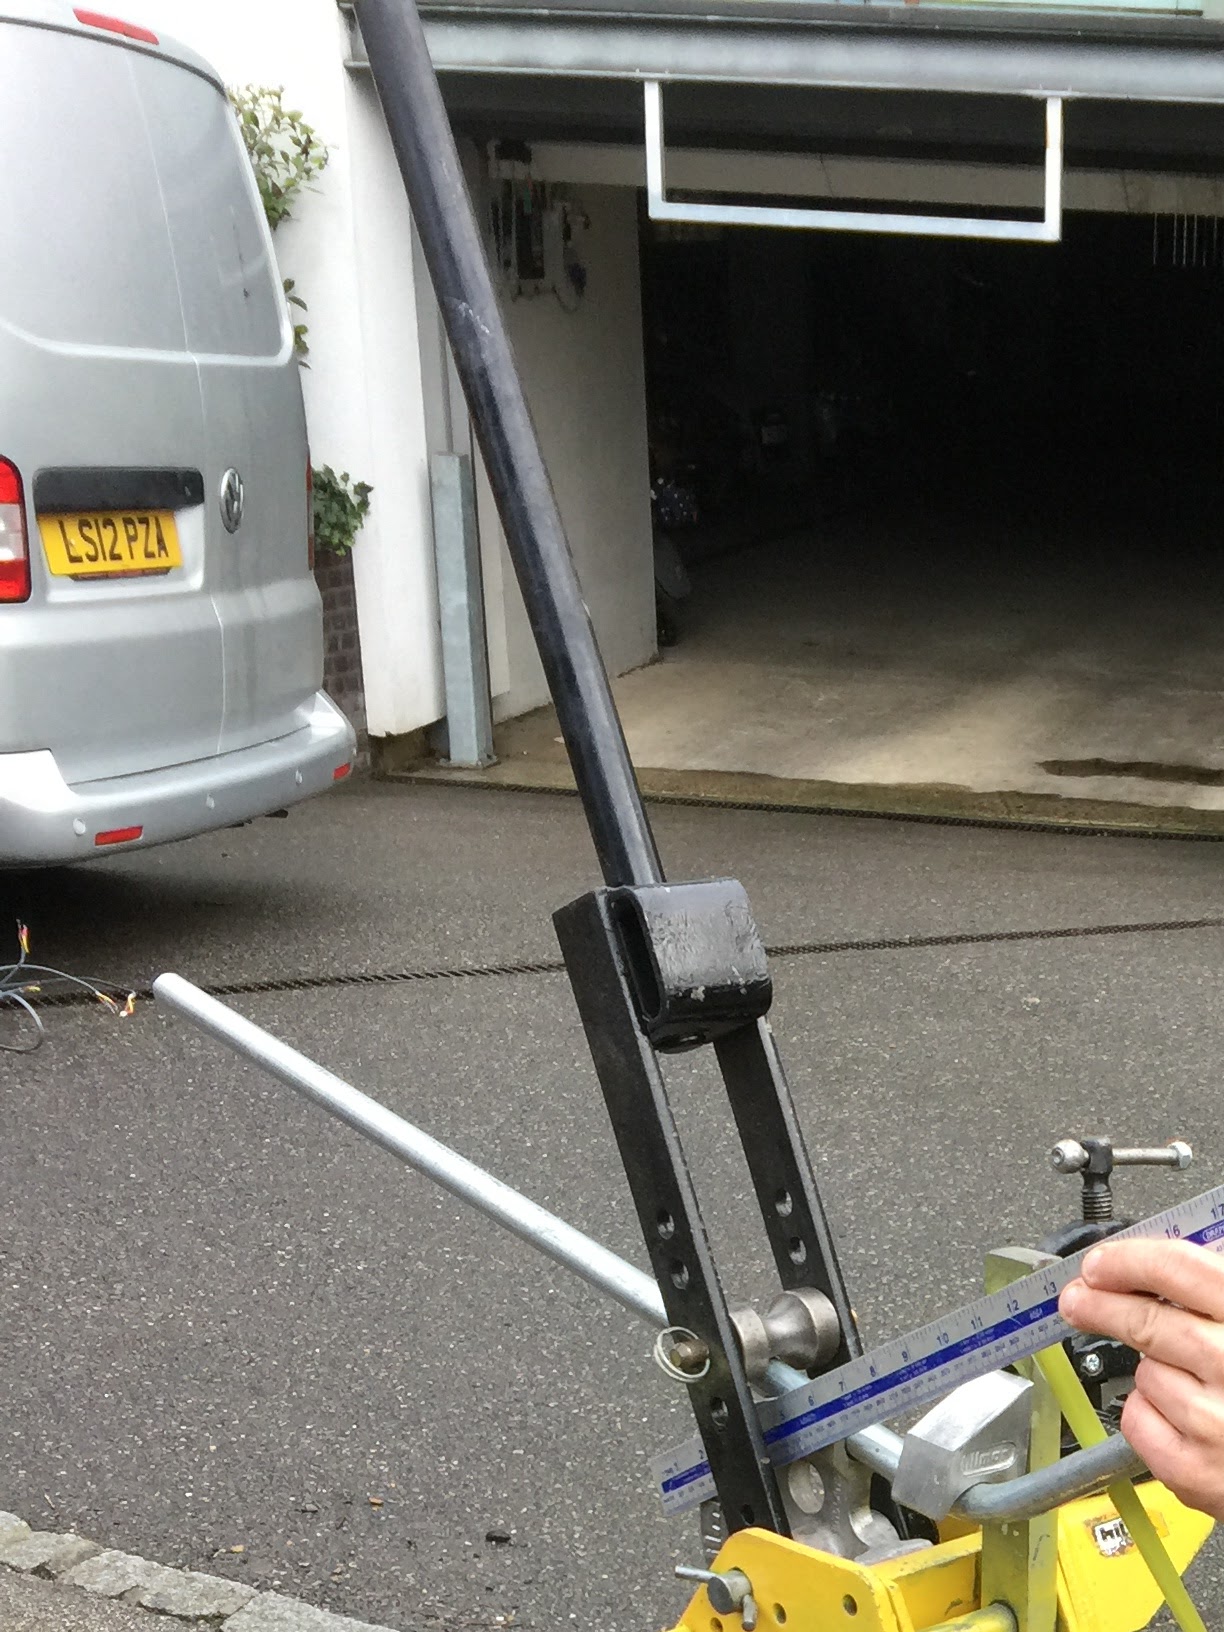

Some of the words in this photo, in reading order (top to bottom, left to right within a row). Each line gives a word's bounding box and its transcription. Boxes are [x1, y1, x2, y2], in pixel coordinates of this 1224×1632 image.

[58, 518, 123, 563] LS12
[122, 516, 169, 560] PZA
[838, 1381, 845, 1392] 7
[869, 1365, 877, 1378] 8
[902, 1351, 909, 1363] 9
[936, 1333, 950, 1347] 10
[970, 1316, 983, 1330] 11
[1006, 1299, 1020, 1313] 12
[1043, 1281, 1057, 1297] 13
[1165, 1224, 1181, 1240] 16
[1210, 1203, 1224, 1220] 17
[1099, 1520, 1129, 1542] hil
